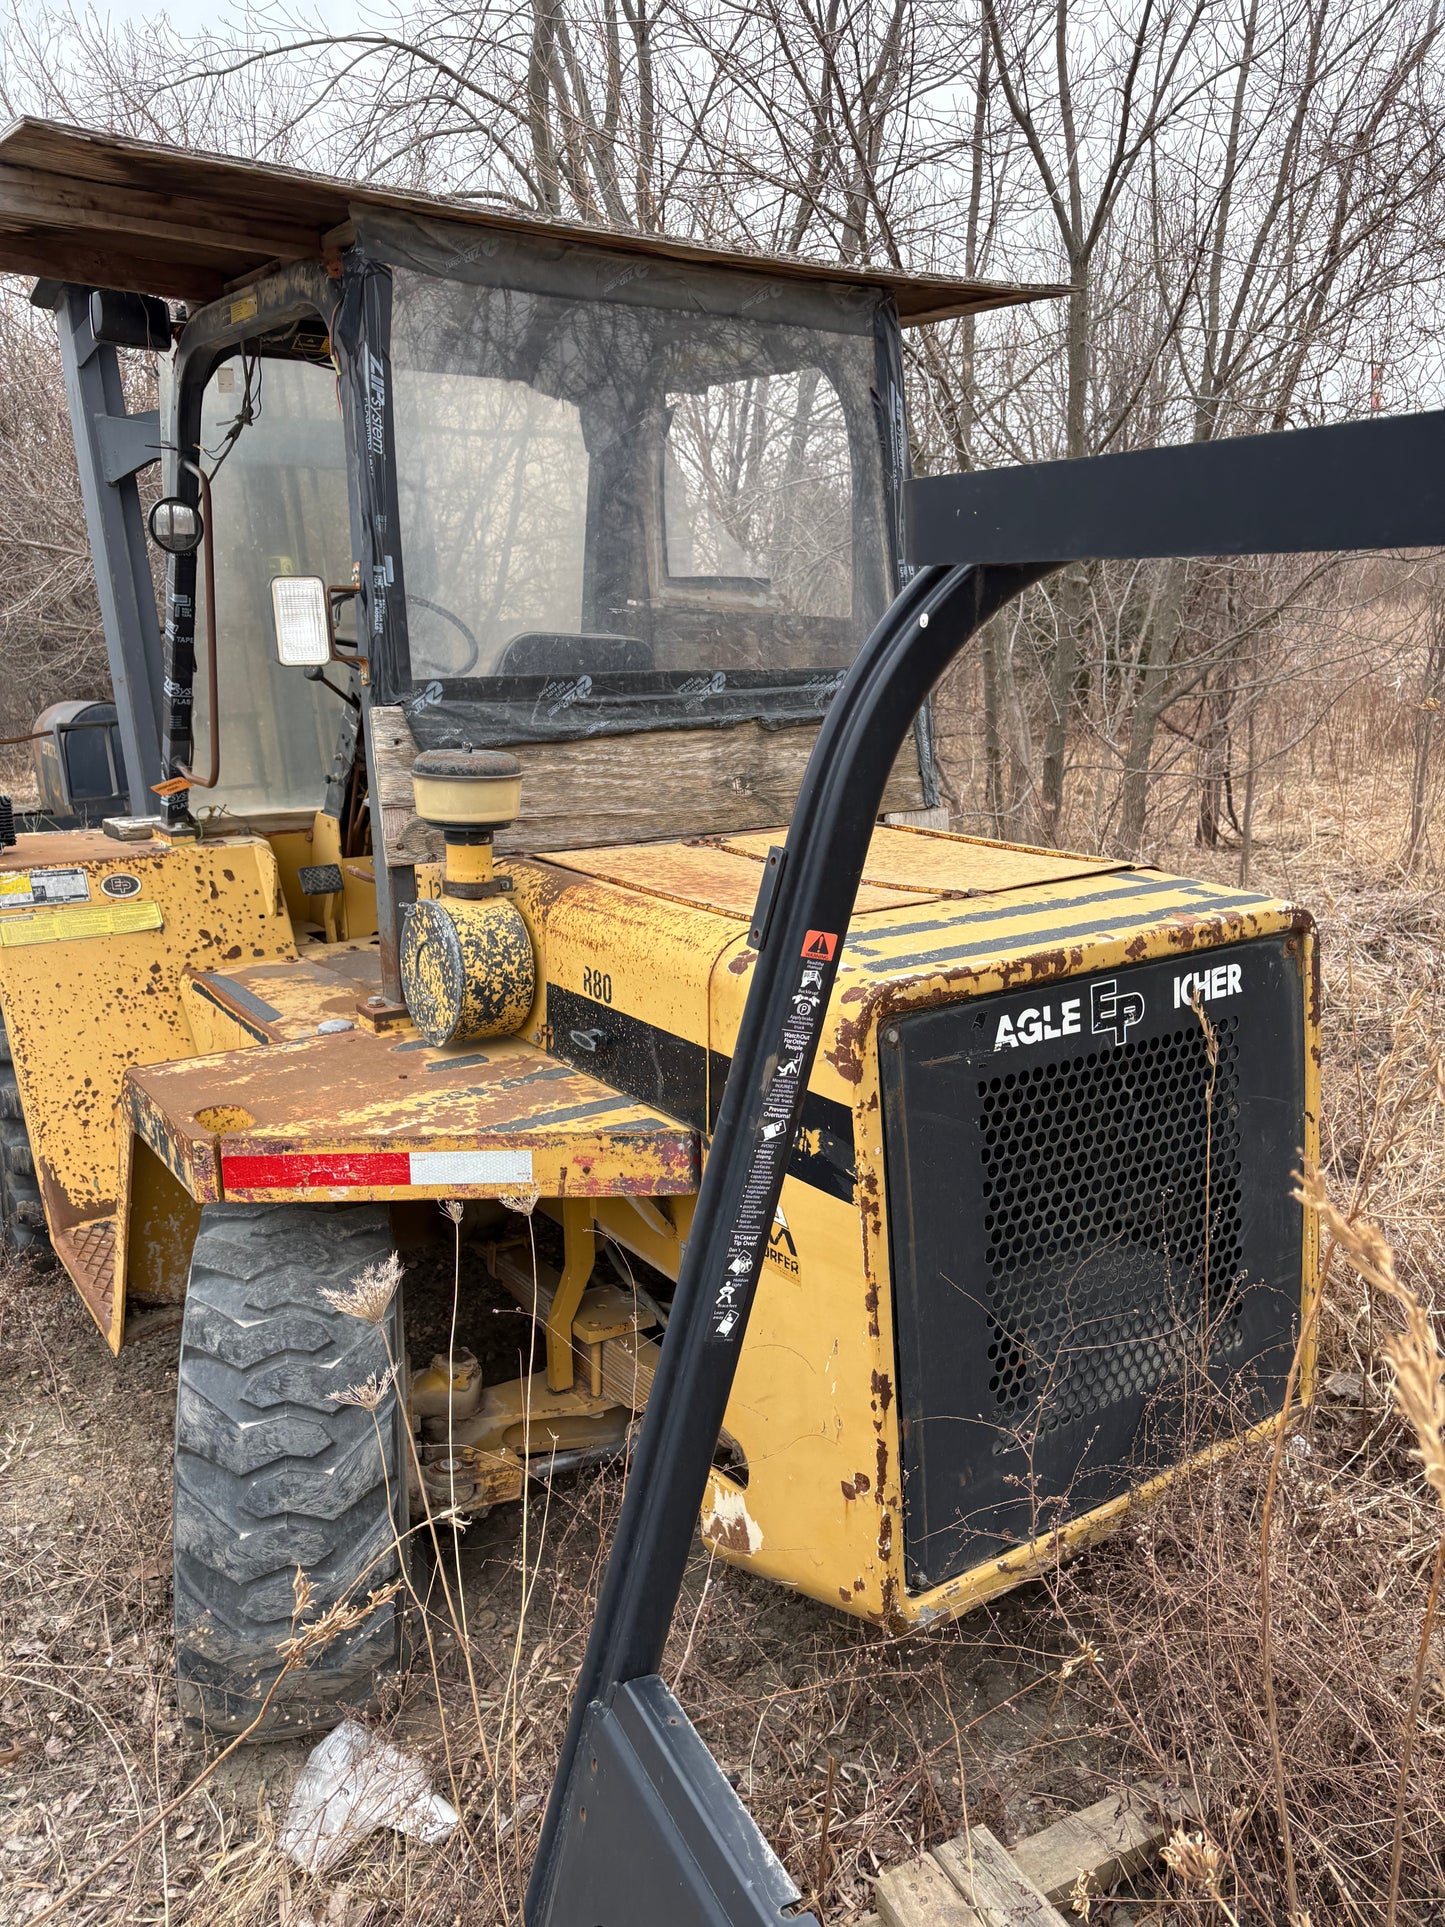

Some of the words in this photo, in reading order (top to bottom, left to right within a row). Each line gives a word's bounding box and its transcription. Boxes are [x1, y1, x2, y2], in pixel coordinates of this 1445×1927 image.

[805, 952, 829, 960] WARNING
[783, 1031, 800, 1039] Watch
[785, 1043, 803, 1051] People
